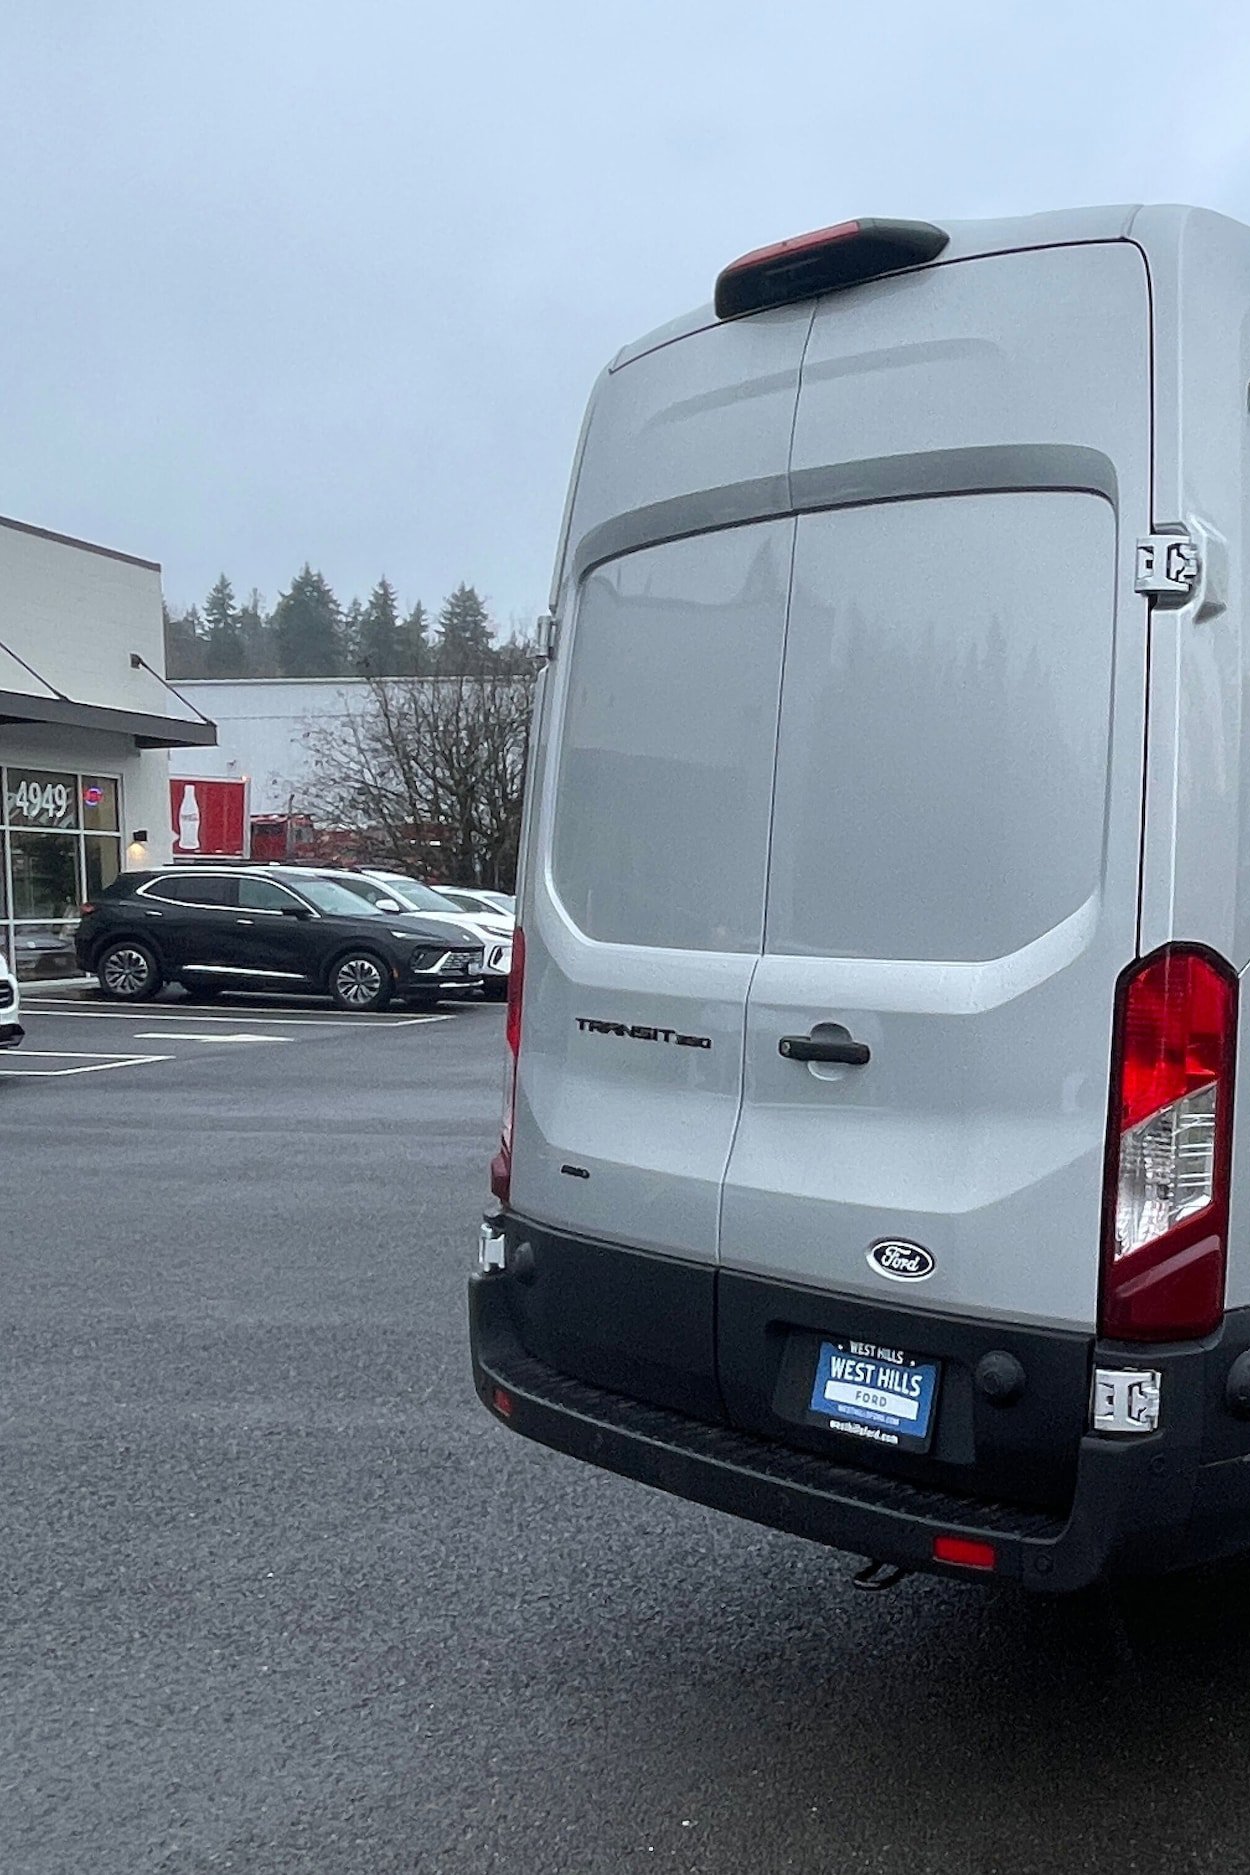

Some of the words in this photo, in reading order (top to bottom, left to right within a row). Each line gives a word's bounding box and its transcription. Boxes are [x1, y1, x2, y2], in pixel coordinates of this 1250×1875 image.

[15, 780, 67, 818] 4949
[881, 1246, 920, 1271] Ford
[849, 1340, 876, 1357] WEST
[877, 1346, 904, 1365] HILLS
[830, 1356, 876, 1384] WEST
[877, 1367, 922, 1397] HILLS
[855, 1390, 887, 1408] FORD
